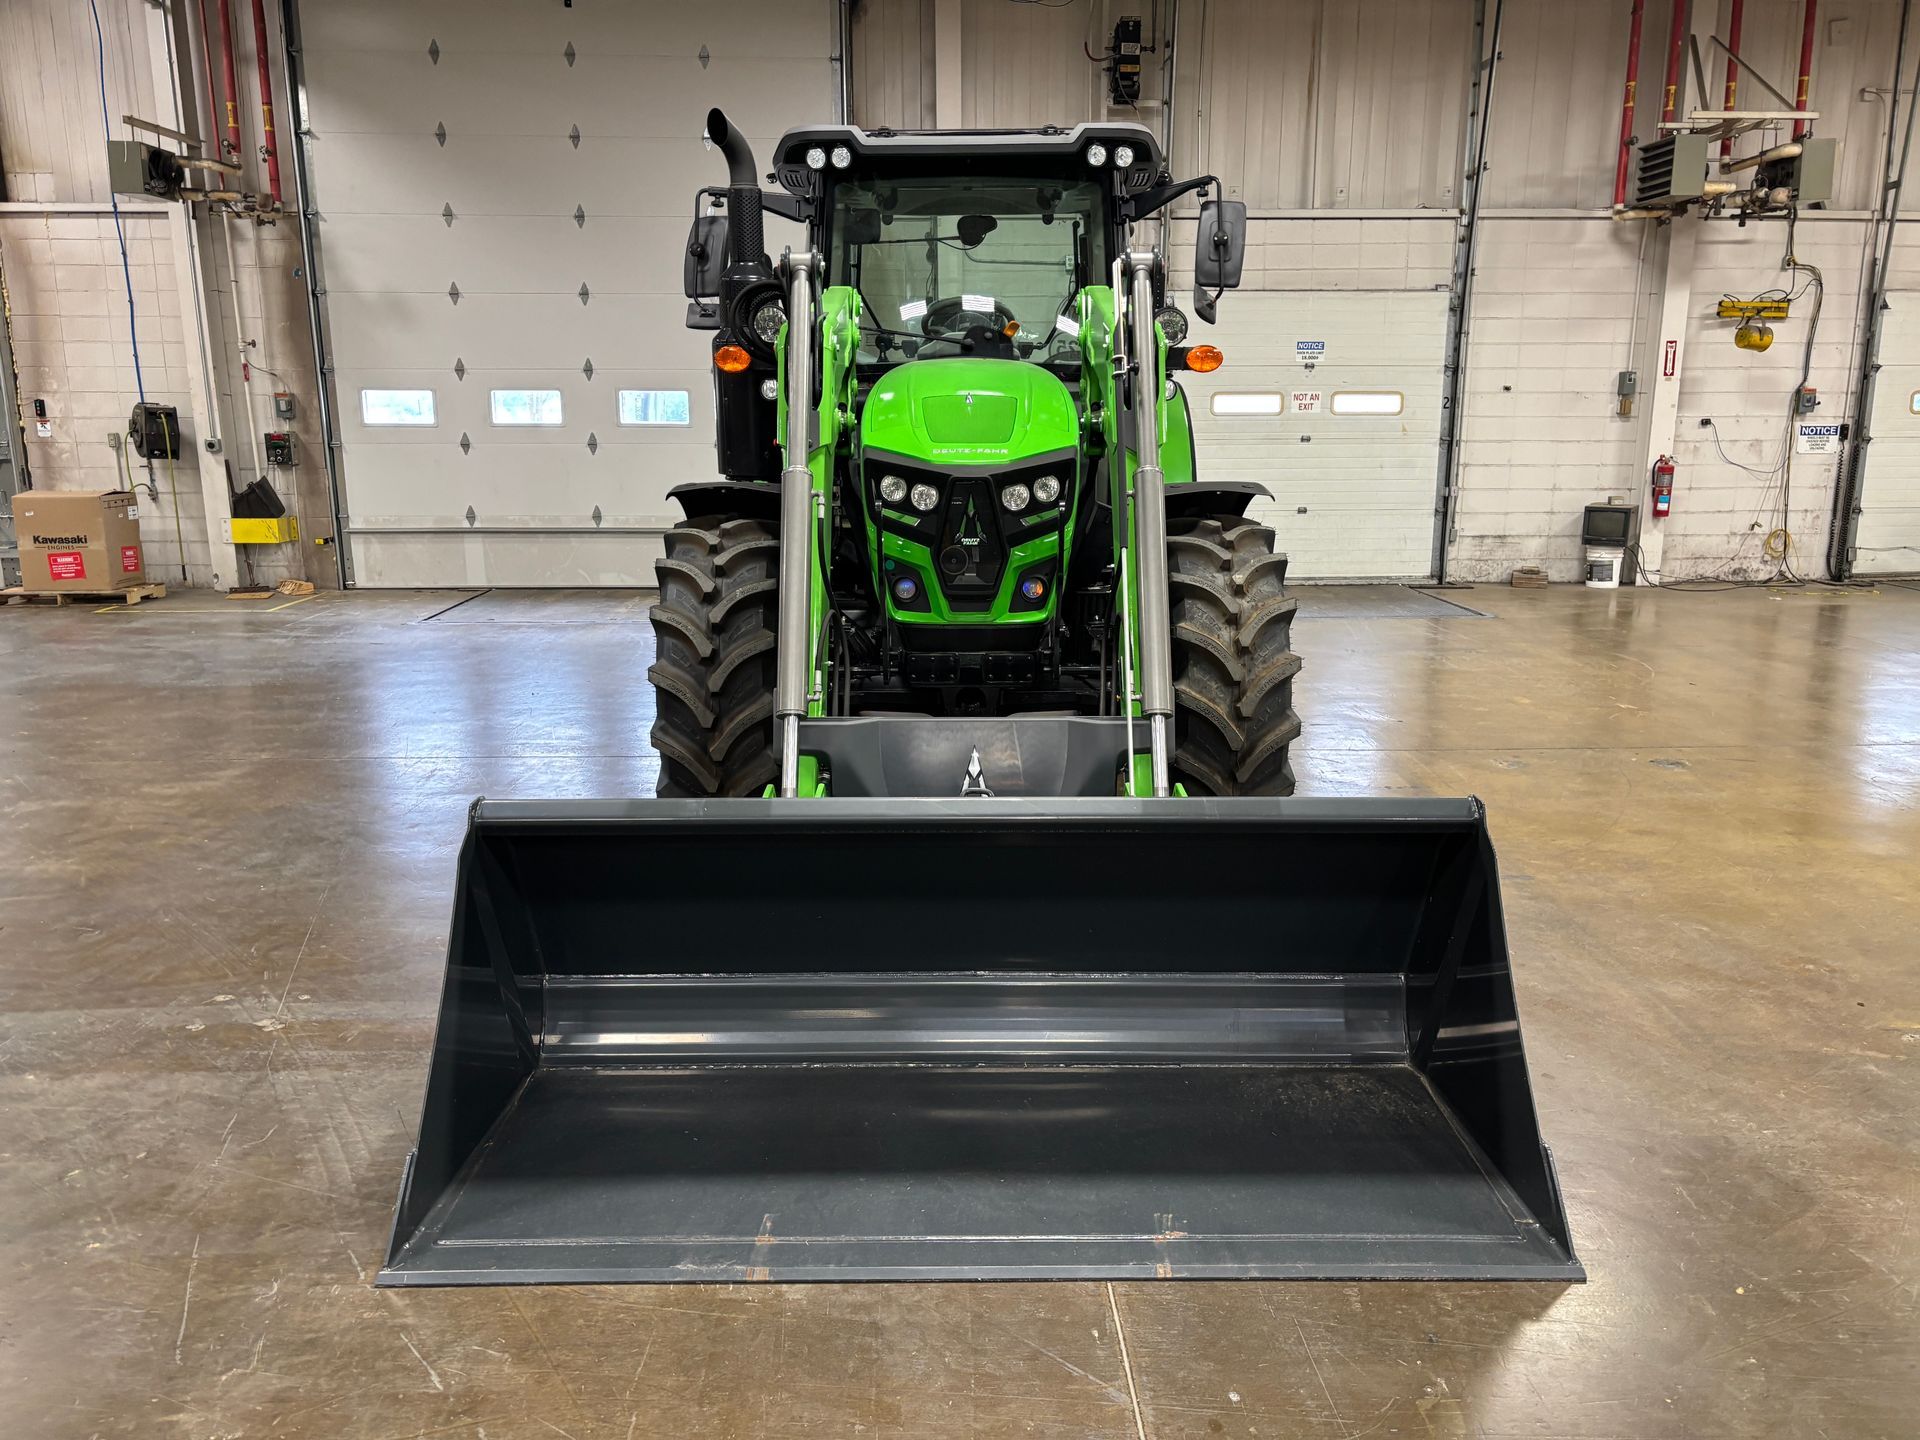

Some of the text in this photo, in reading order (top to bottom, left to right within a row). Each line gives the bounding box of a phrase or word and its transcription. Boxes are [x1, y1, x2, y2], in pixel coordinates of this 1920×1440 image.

[1297, 342, 1324, 350] NOTICE
[1293, 393, 1320, 401] NOT AN
[1443, 396, 1450, 409] 2
[1298, 403, 1314, 411] EXIT
[1801, 426, 1837, 435] NOTICE
[33, 535, 88, 545] Kawasaki
